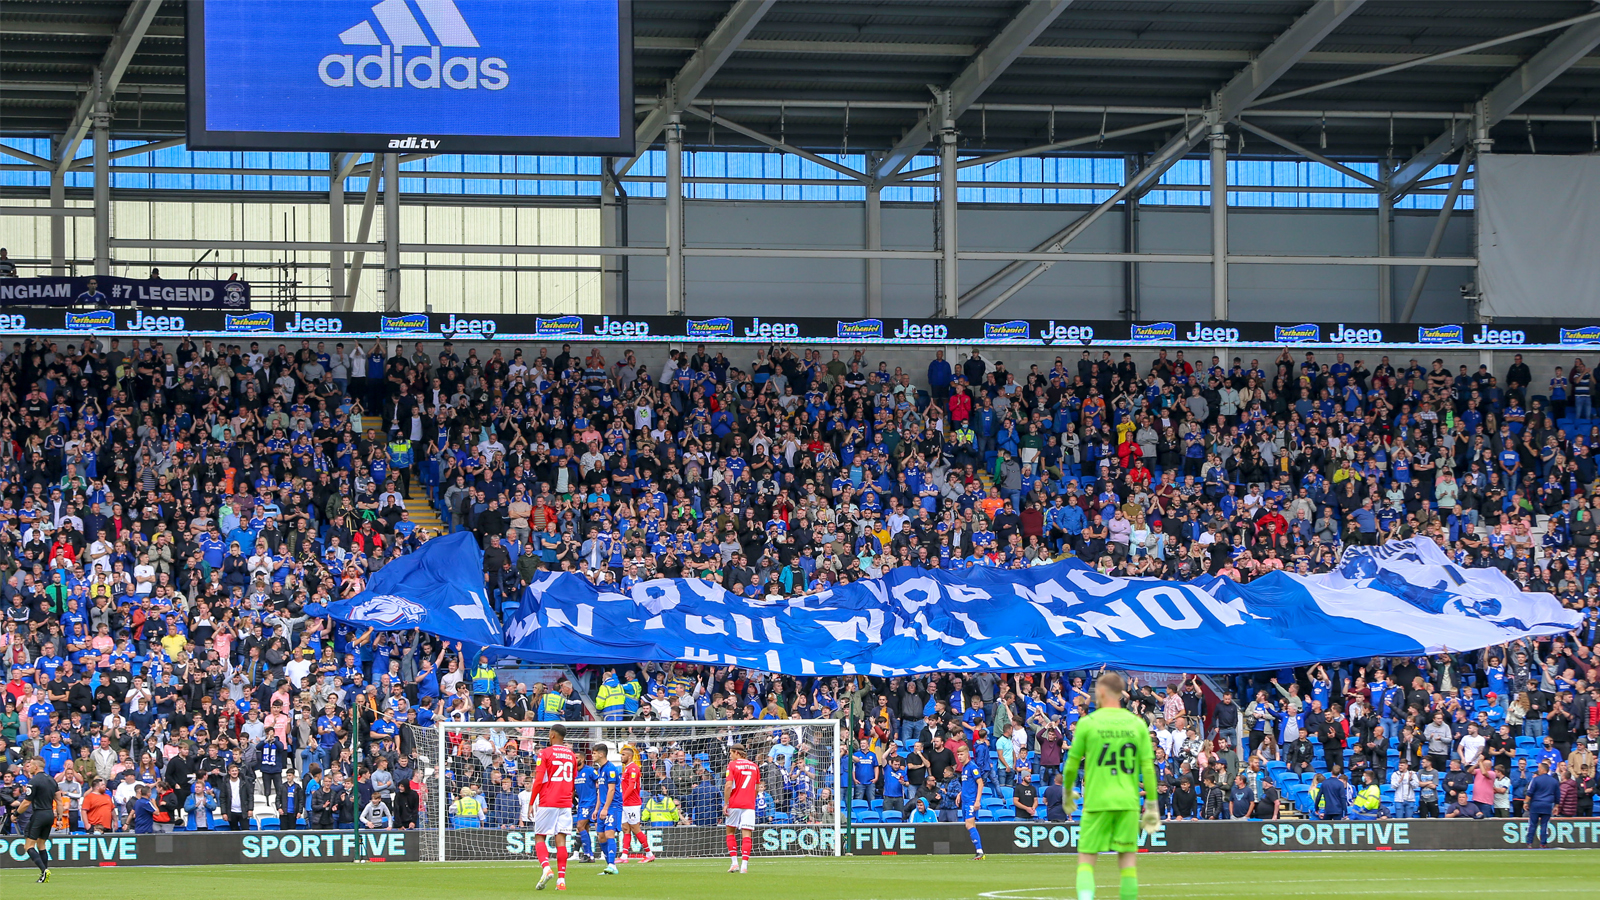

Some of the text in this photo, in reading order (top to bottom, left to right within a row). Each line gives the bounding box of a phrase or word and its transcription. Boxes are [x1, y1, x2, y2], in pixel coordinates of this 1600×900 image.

[318, 45, 509, 90] adidas
[388, 137, 440, 149] adi.tv
[1, 283, 71, 299] NGHAM
[112, 284, 215, 302] #7 LEGEND
[126, 310, 185, 330] Jeep
[286, 313, 343, 331] Jeep
[440, 314, 496, 333] Jeep
[594, 316, 649, 335] Jeep
[744, 318, 799, 336] Jeep
[893, 320, 947, 338] Jeep
[1040, 321, 1093, 339] Jeep
[1186, 323, 1239, 341] Jeep
[1329, 324, 1382, 342] Jeep
[1473, 325, 1525, 344] Jeep
[1144, 672, 1169, 681] USW
[1097, 743, 1137, 775] 40
[551, 760, 574, 783] 20
[741, 770, 752, 789] 7
[1261, 823, 1409, 845] SPORTFIVE
[242, 833, 406, 857] SPORTFIVE
